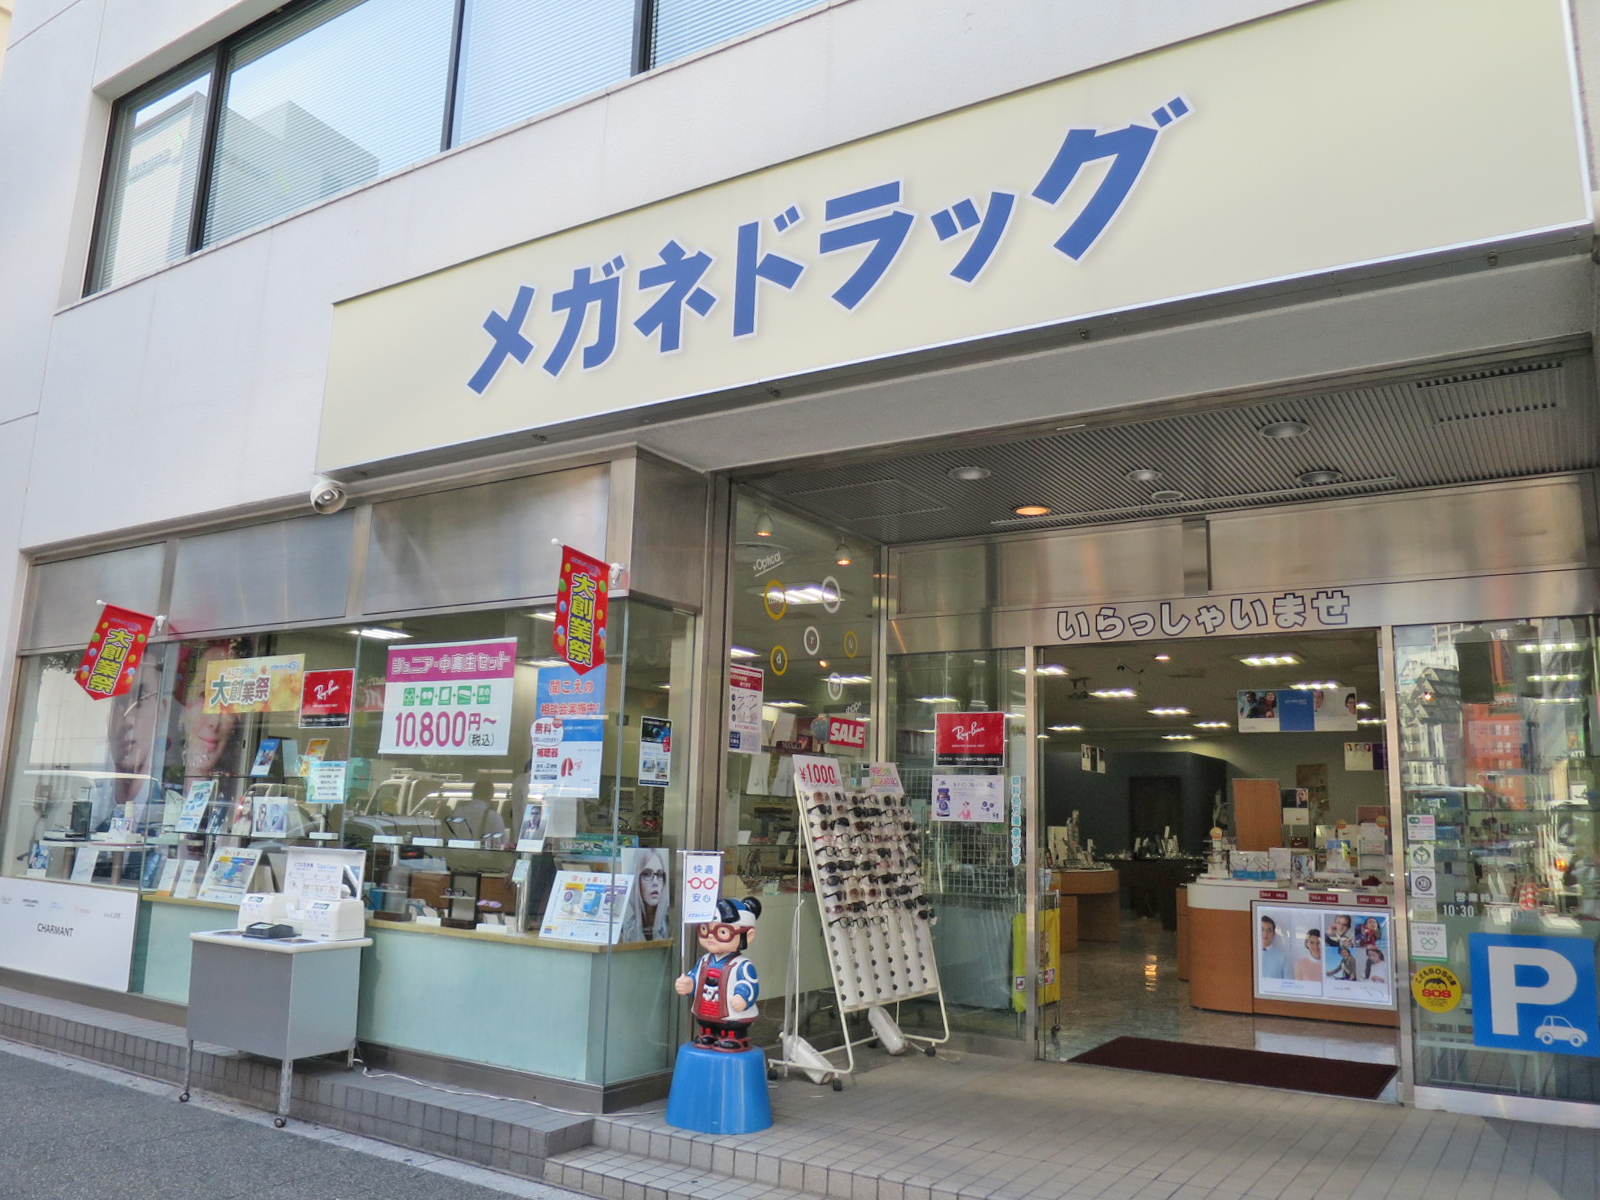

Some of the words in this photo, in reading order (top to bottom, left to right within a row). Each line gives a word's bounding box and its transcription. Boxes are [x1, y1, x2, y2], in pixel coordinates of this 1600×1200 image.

[466, 96, 1191, 394] メガネドラッグ
[568, 574, 596, 667] 大創業祭
[1057, 590, 1350, 640] いらっしゃいませ
[87, 629, 134, 694] 大創業祭
[209, 675, 271, 707] 大創業祭
[549, 680, 594, 695] 聞こえの
[468, 733, 495, 748] (税込)
[829, 722, 864, 744] SALE
[952, 721, 985, 741] Ray-Ban
[693, 864, 714, 875] 快適
[692, 893, 711, 903] 安心
[37, 923, 74, 937] CHARMANT
[1422, 988, 1452, 998] SOS
[1487, 946, 1578, 1036] P
